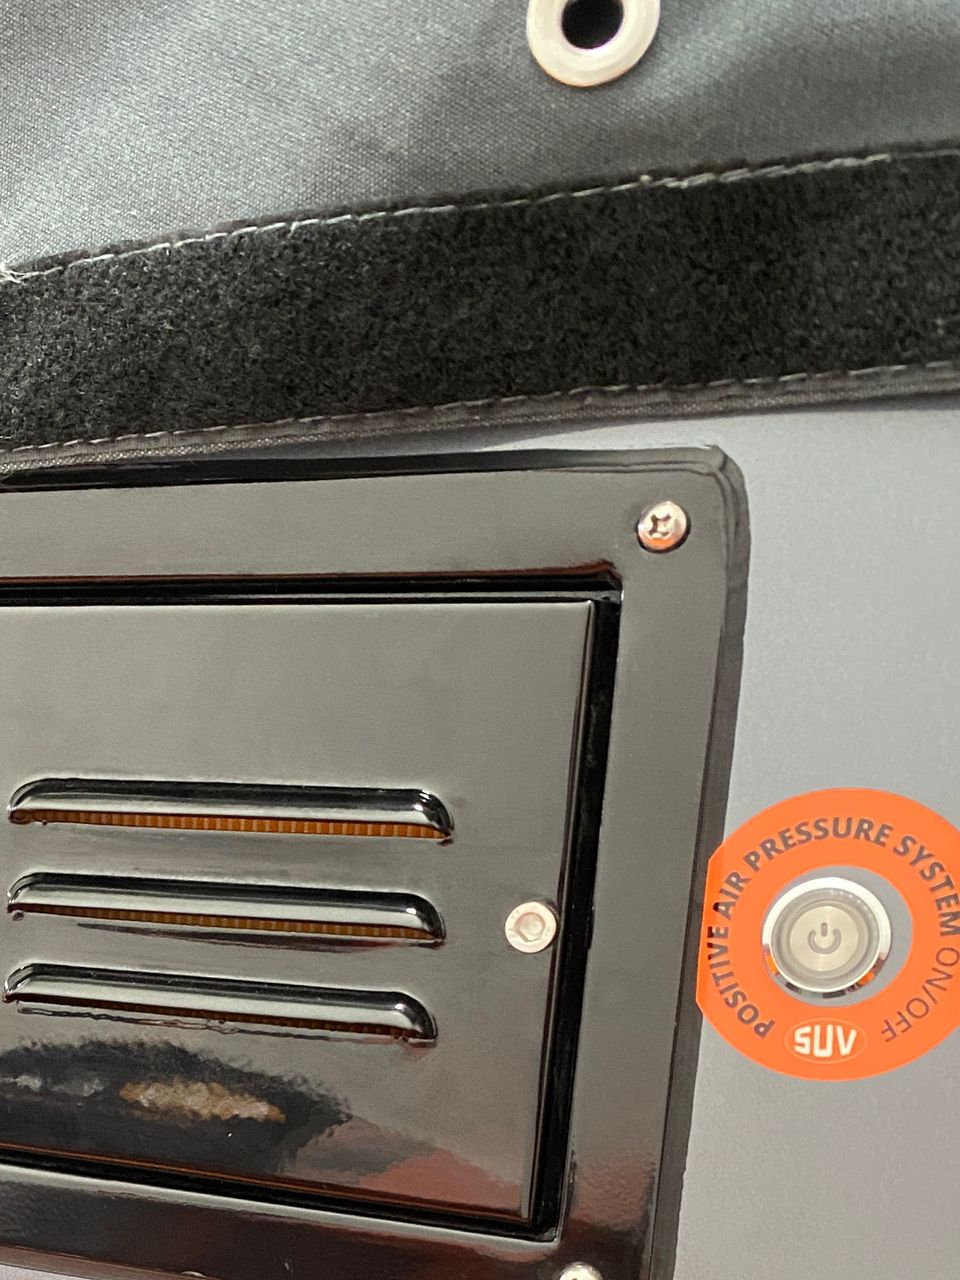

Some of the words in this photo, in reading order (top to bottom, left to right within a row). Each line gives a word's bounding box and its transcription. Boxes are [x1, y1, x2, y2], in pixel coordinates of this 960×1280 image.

[743, 816, 894, 873] PRESSURE
[712, 870, 750, 921] AIR
[893, 835, 960, 937] SYSTEM
[707, 925, 775, 1039] POSITIVE
[881, 946, 960, 1043] ON/OFF
[793, 1023, 858, 1058] SUV
